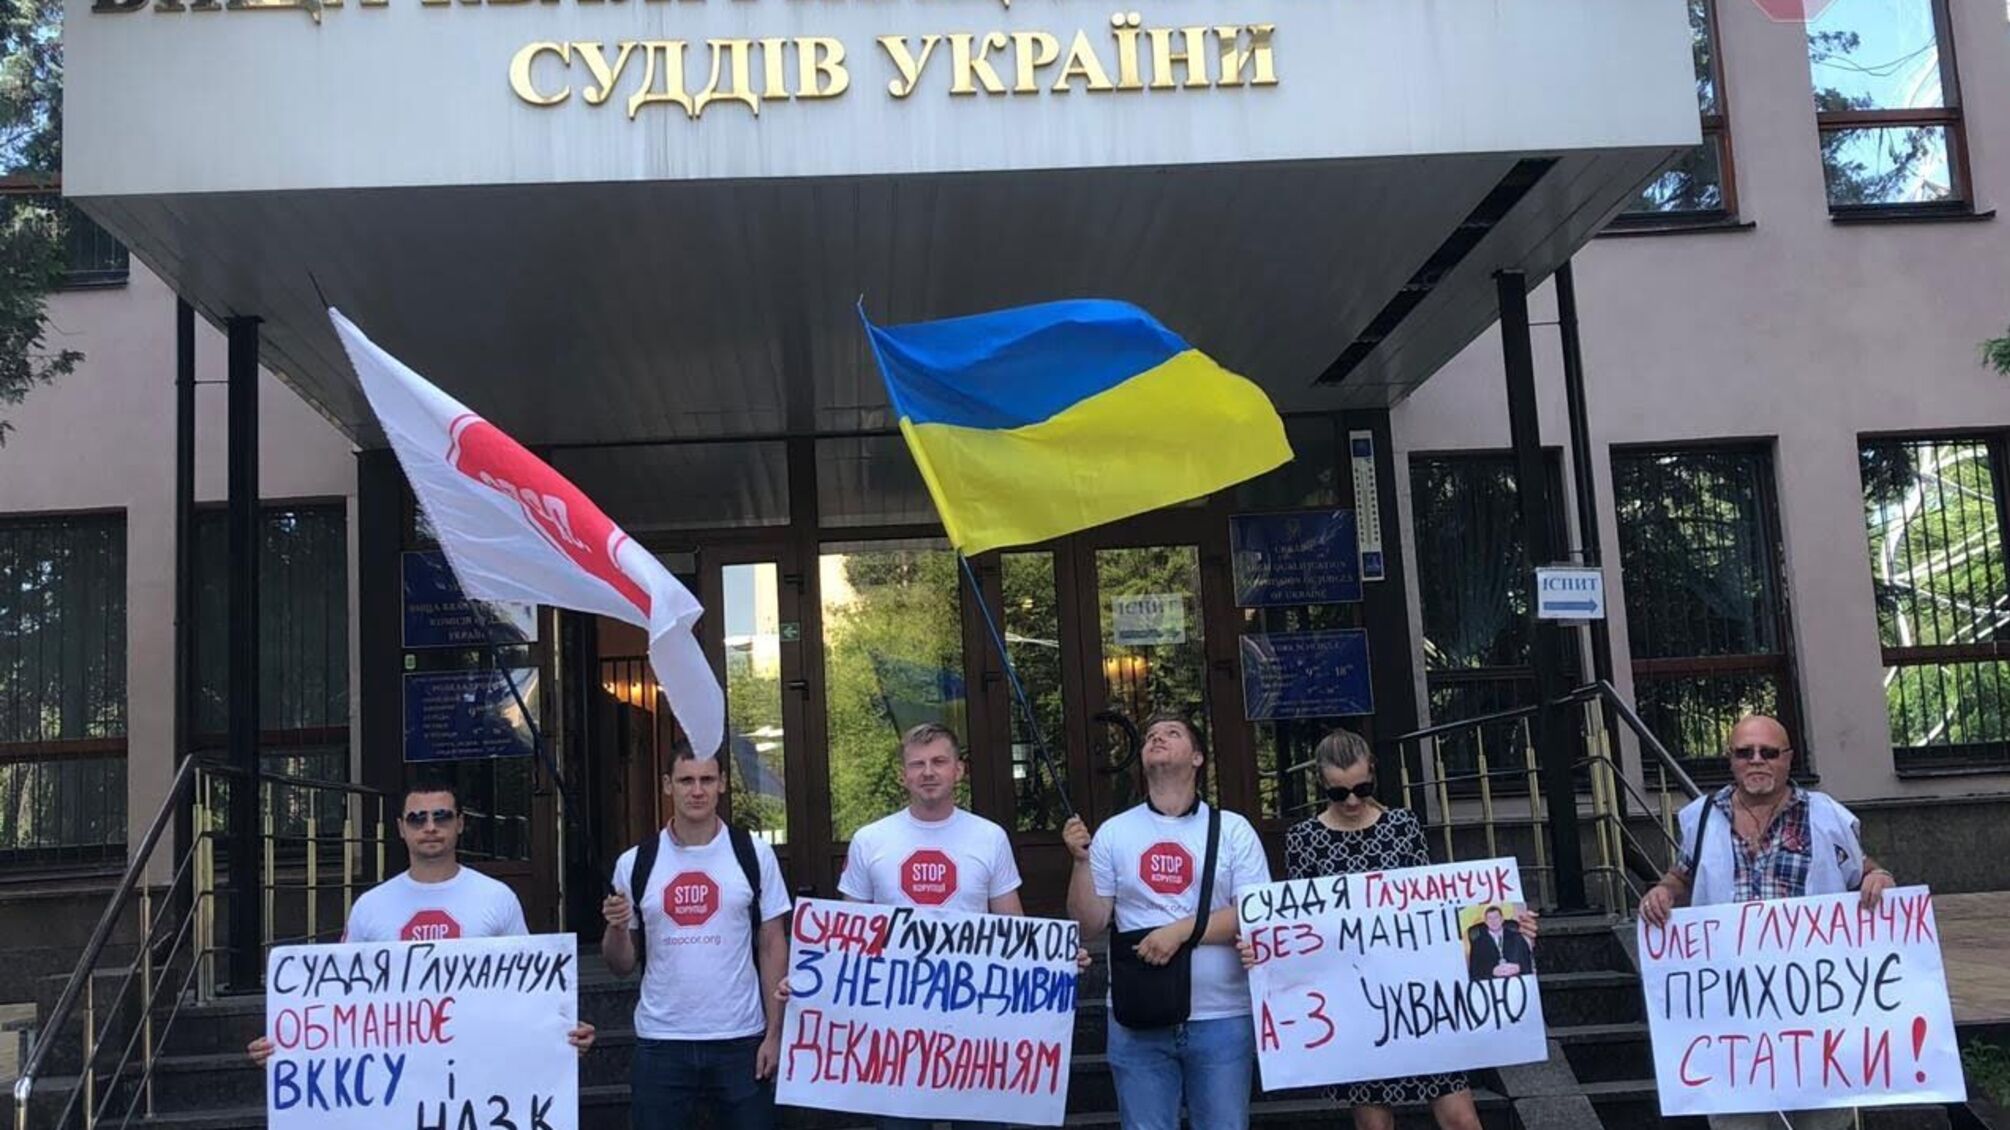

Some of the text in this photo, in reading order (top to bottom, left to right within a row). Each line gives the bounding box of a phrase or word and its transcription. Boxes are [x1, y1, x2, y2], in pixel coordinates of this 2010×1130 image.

[509, 12, 1279, 120] СУДДІВ УКРАЇНИ
[1543, 577, 1598, 591] ІСПИТ
[912, 863, 946, 881] STOP
[1151, 854, 1183, 873] STOP
[674, 884, 708, 904] STOP
[1242, 866, 1514, 923] СУДДЯ ГЛУХАНЧУК
[412, 923, 449, 940] STOP
[794, 902, 889, 958] СУДДЯ
[883, 907, 1042, 962] ГЛУХАНЧУК
[1250, 923, 1324, 966] БЕЗ
[1645, 894, 1934, 961] ОЛЕГ ГЛУХАНЧУК
[273, 943, 572, 997] СУДДЯ ГЛУХАНЧУК
[1665, 952, 1902, 1020] ПРИХОВУЄ
[275, 997, 456, 1050] ОБМАНЮЄ
[1360, 975, 1527, 1047] УХВАЛОЮ
[786, 1009, 1062, 1095] ДЕКЛАРУВАННЯМ
[274, 1053, 406, 1111] ВККСУ
